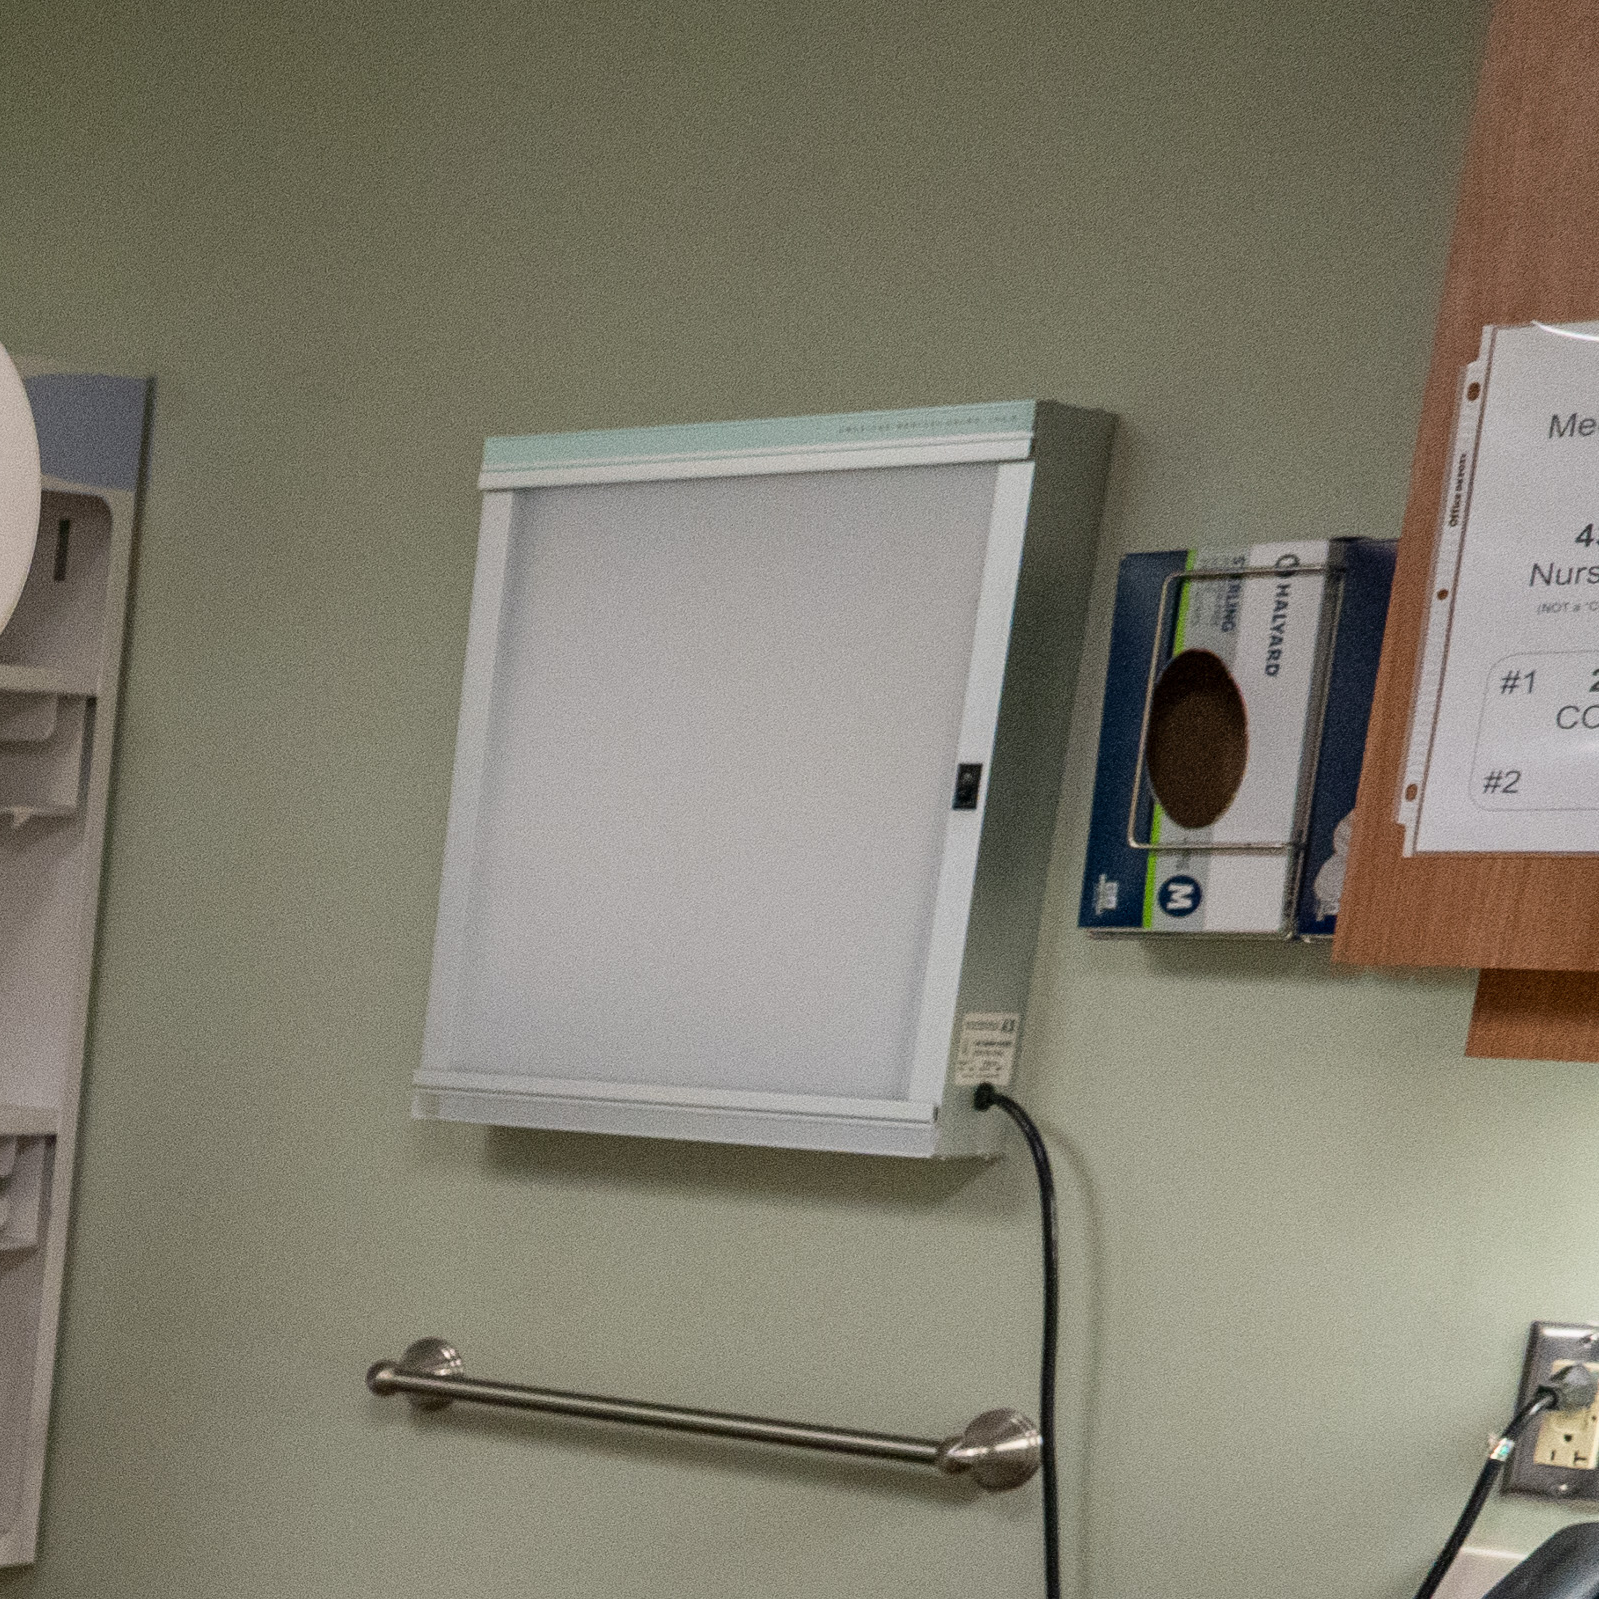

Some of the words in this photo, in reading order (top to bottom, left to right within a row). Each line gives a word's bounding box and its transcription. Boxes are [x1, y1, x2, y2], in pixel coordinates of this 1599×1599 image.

[1574, 523, 1599, 548] 4
[1220, 555, 1245, 633] SRLING
[1263, 582, 1291, 679] HALYARD
[1500, 669, 1536, 694] #1
[1481, 769, 1522, 794] #2
[1164, 882, 1193, 910] M
